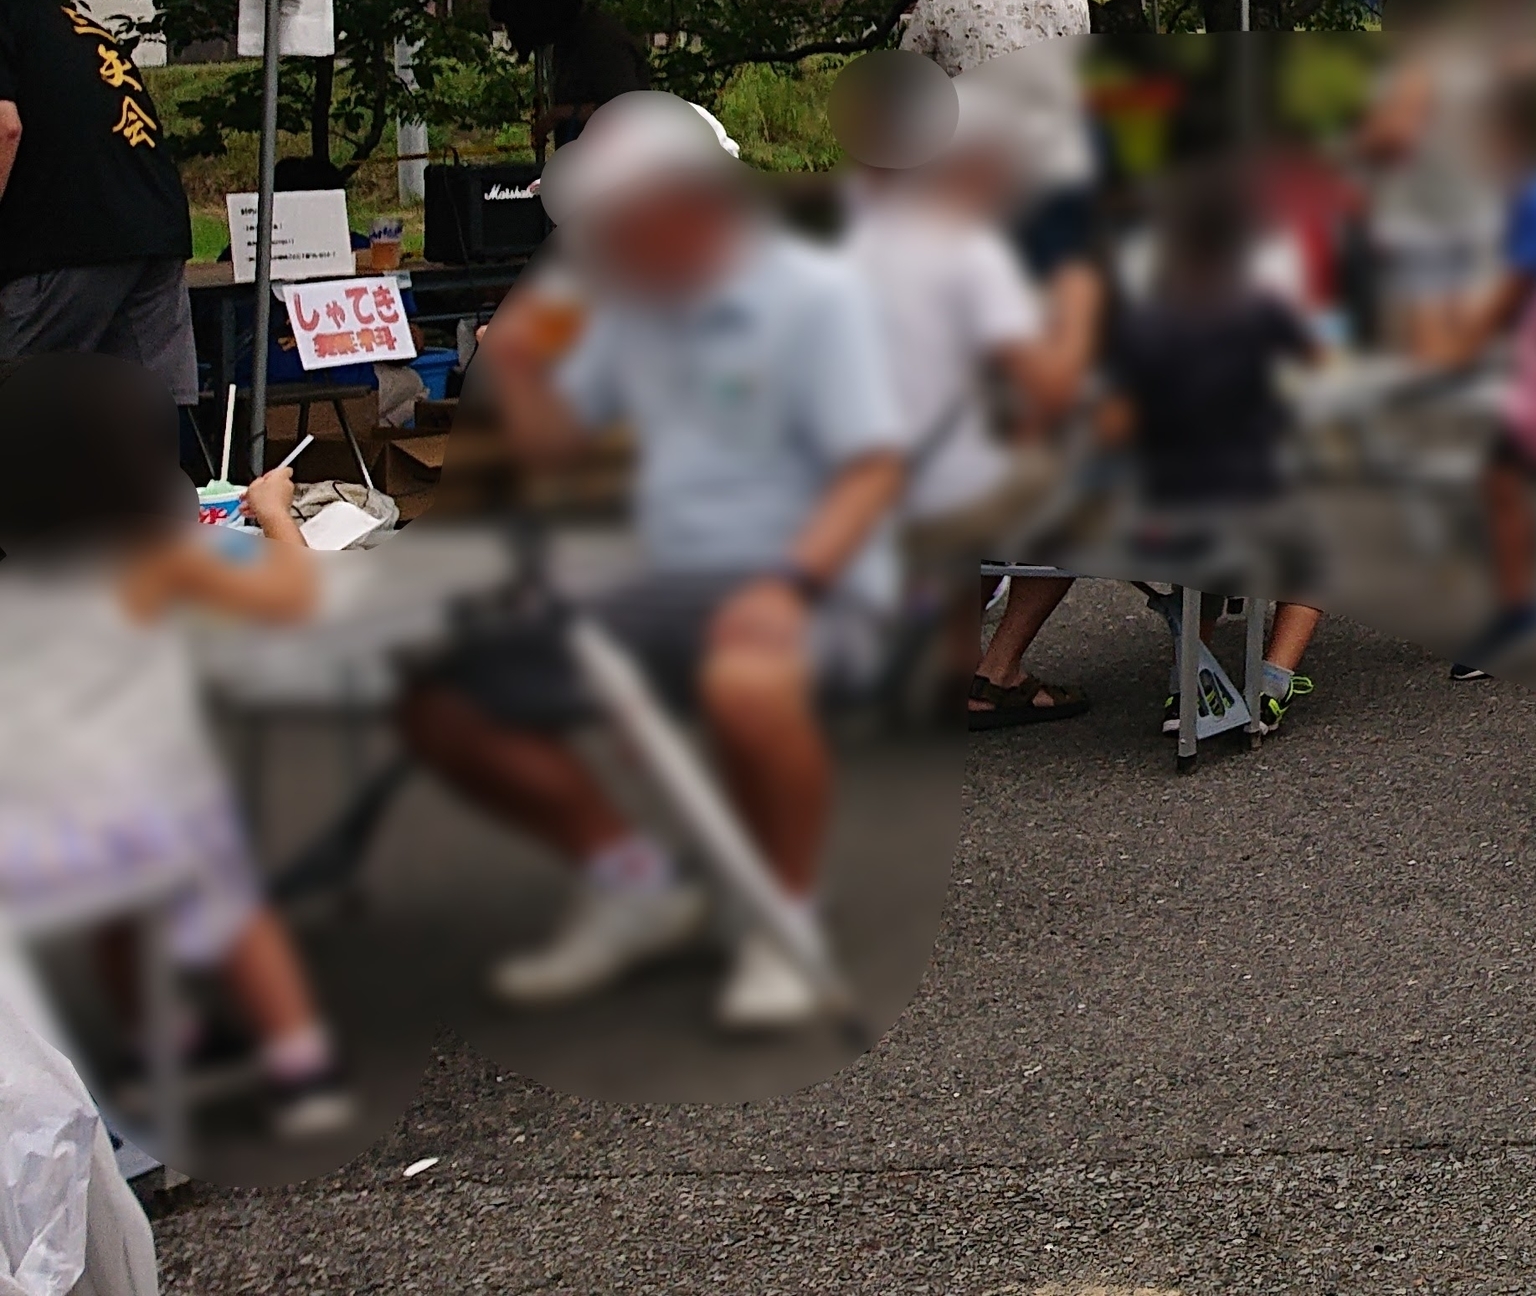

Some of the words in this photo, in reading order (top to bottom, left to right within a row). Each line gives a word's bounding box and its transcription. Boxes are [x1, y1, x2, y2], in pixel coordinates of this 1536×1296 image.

[293, 285, 400, 331] しゃてき
[312, 326, 397, 358] 無料
